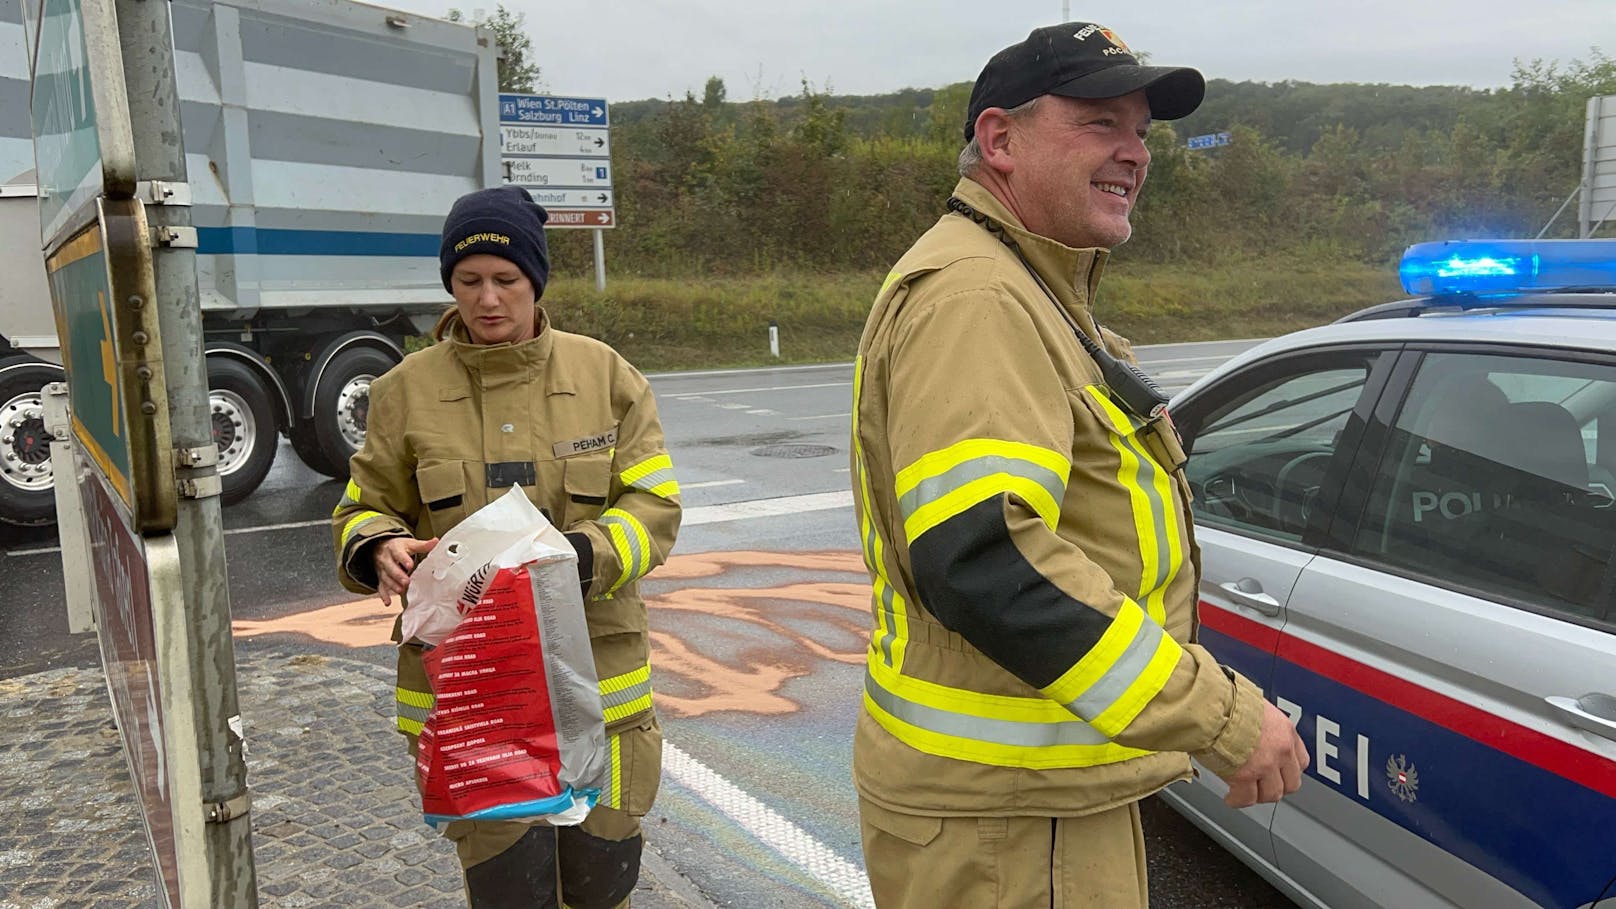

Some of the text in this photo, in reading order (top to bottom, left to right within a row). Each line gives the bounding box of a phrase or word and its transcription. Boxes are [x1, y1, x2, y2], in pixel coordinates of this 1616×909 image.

[504, 103, 515, 114] A1
[517, 98, 542, 109] Wien
[518, 110, 590, 123] Salzburg Linz
[506, 142, 536, 152] Erlauf
[533, 193, 566, 202] ahnhof
[455, 233, 511, 253] FEUERWEHR
[573, 436, 606, 451] PEHAM
